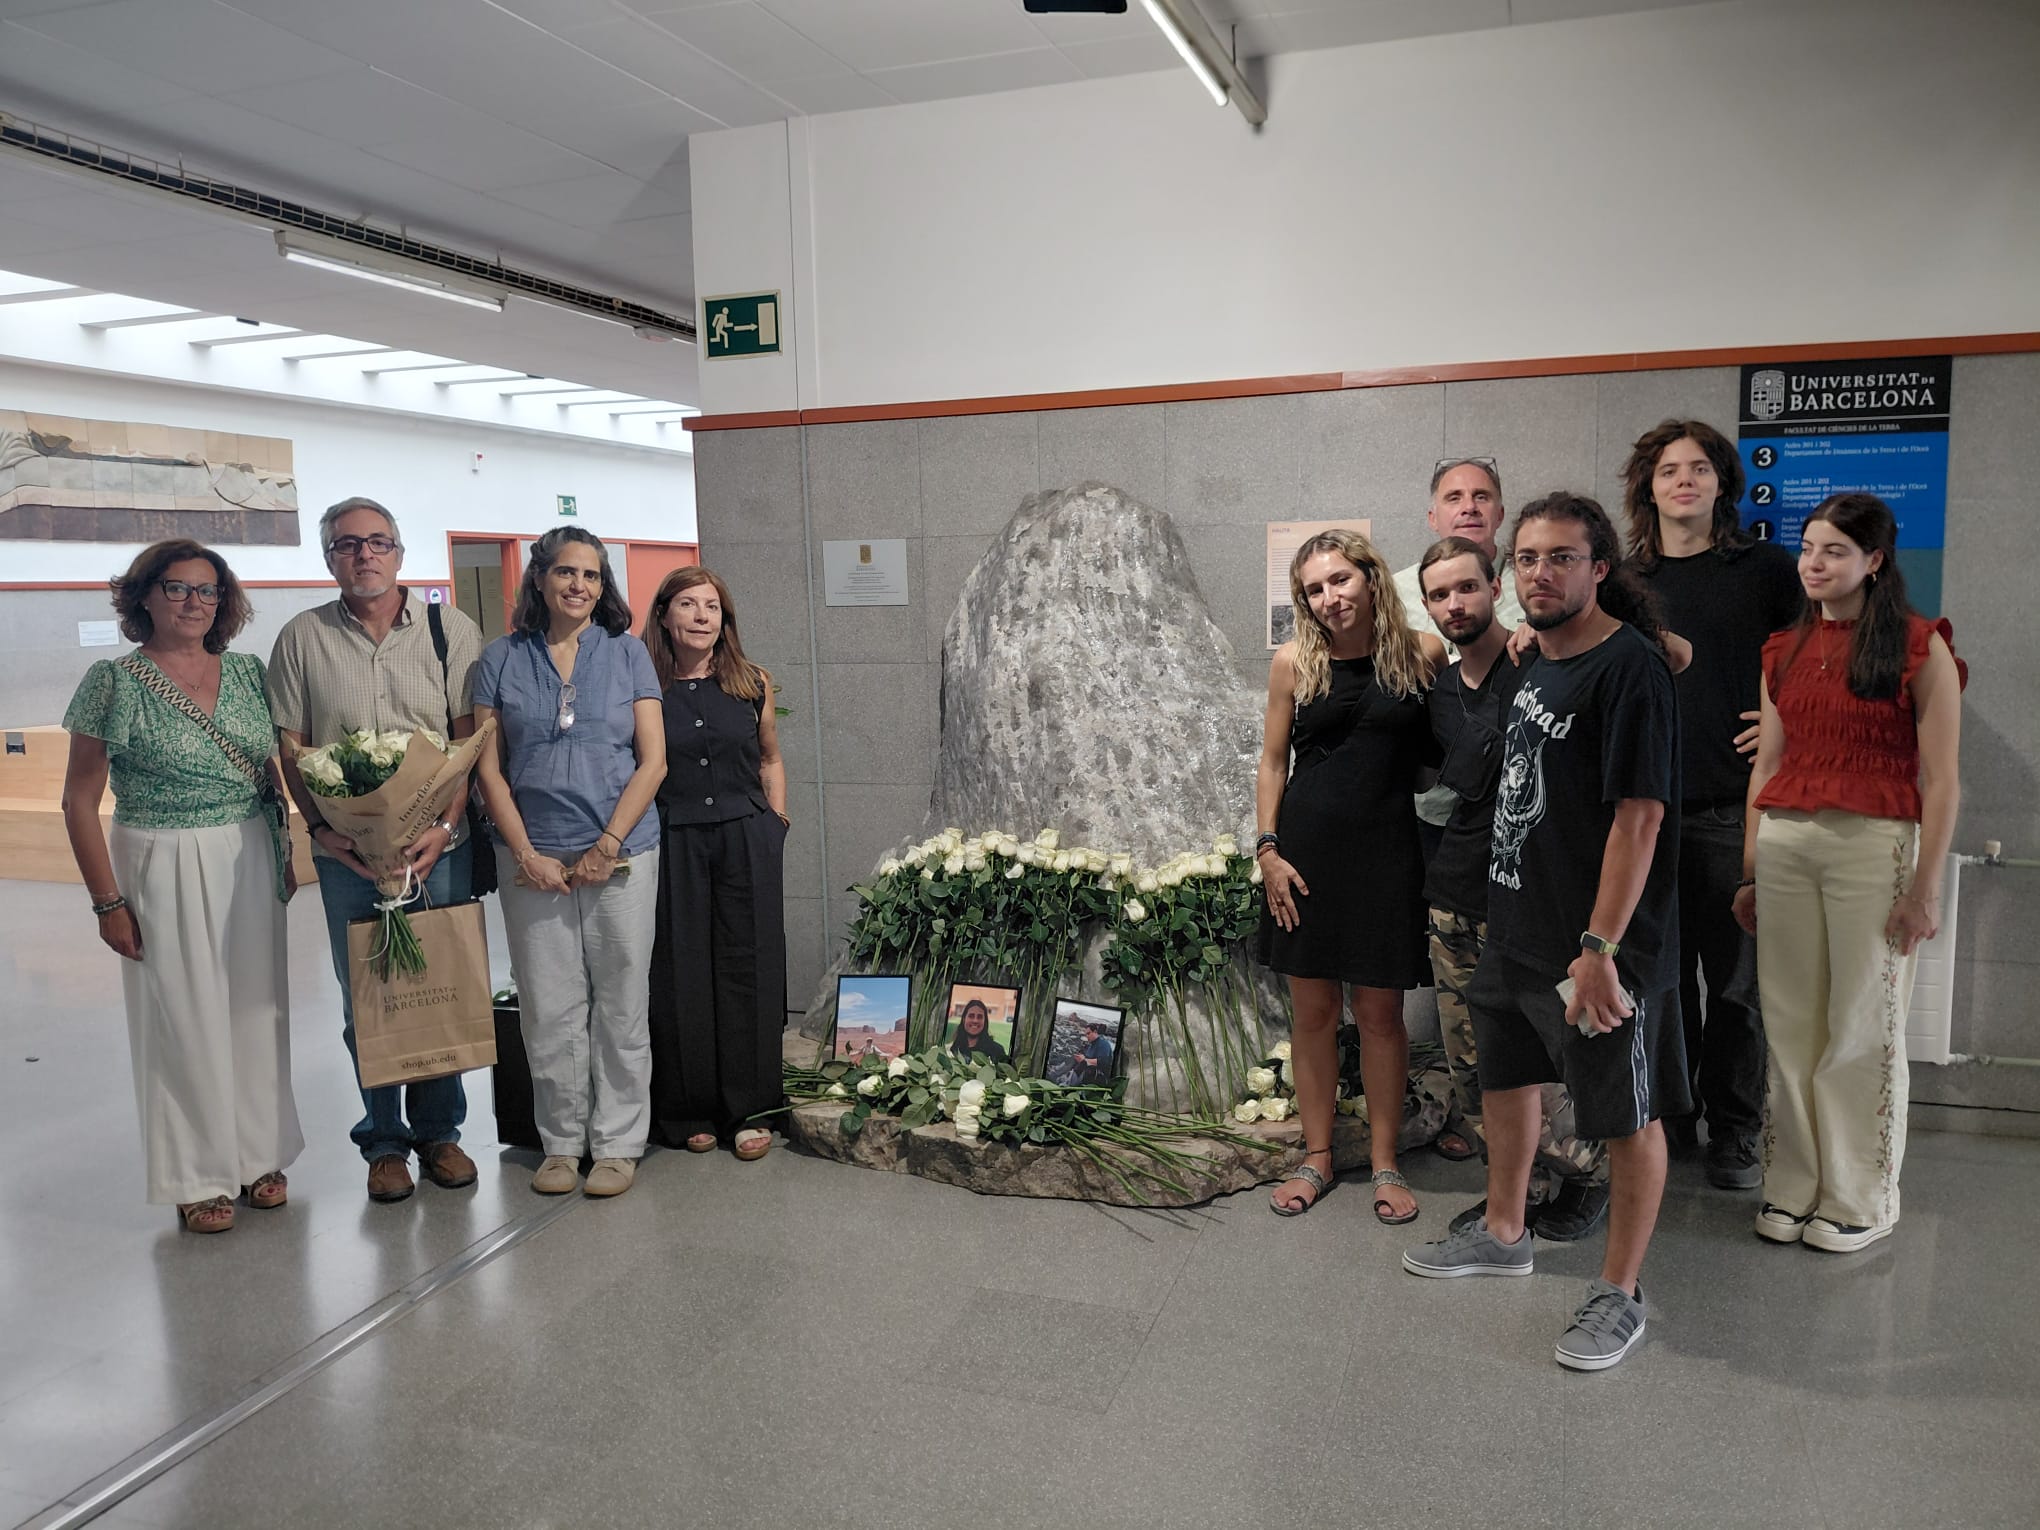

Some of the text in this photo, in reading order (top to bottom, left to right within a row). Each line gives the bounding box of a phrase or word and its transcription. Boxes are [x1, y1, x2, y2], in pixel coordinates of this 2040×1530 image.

[1791, 372, 1935, 392] UNIVERSITAT DE
[1789, 388, 1935, 411] BARCELONA
[1758, 447, 1771, 467] 3
[1757, 485, 1770, 504] 2
[1757, 522, 1768, 541] 1
[383, 986, 448, 1004] UNIVERSITAT
[384, 993, 459, 1014] BARCELONA
